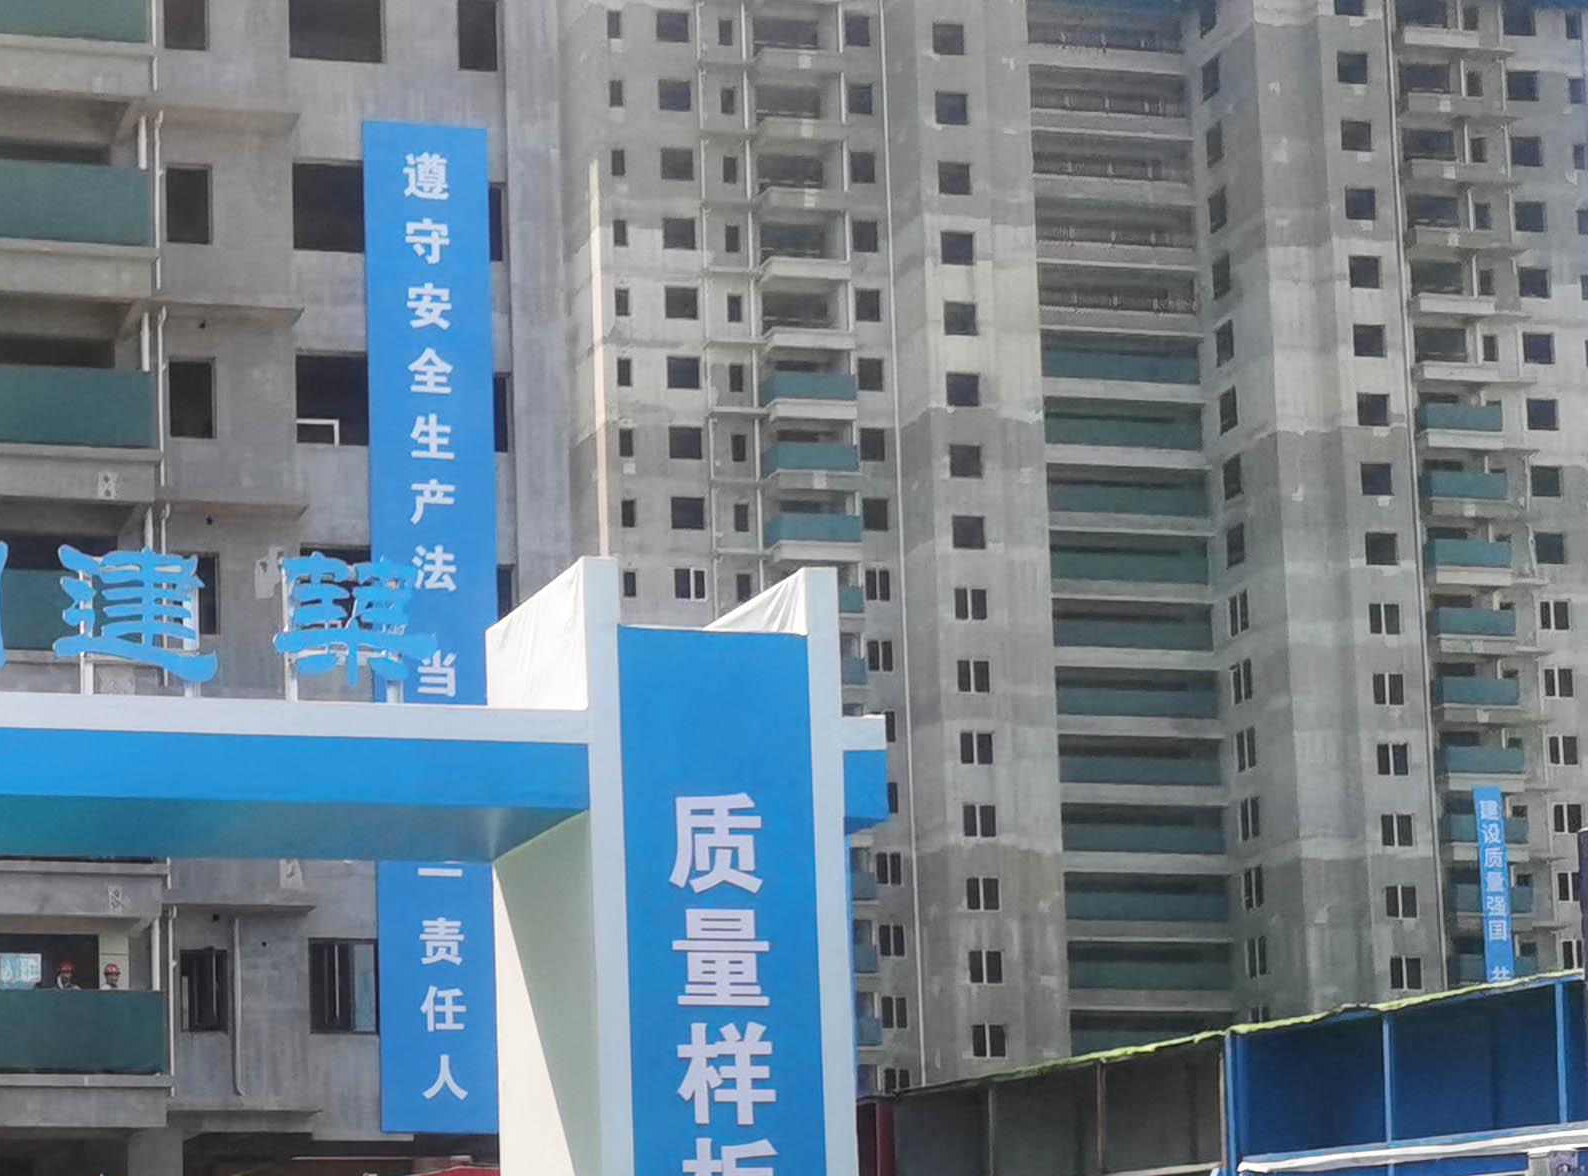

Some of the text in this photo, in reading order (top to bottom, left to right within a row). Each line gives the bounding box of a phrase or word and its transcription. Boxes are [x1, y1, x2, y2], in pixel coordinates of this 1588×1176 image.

[402, 152, 457, 592] 遵守安全生产法
